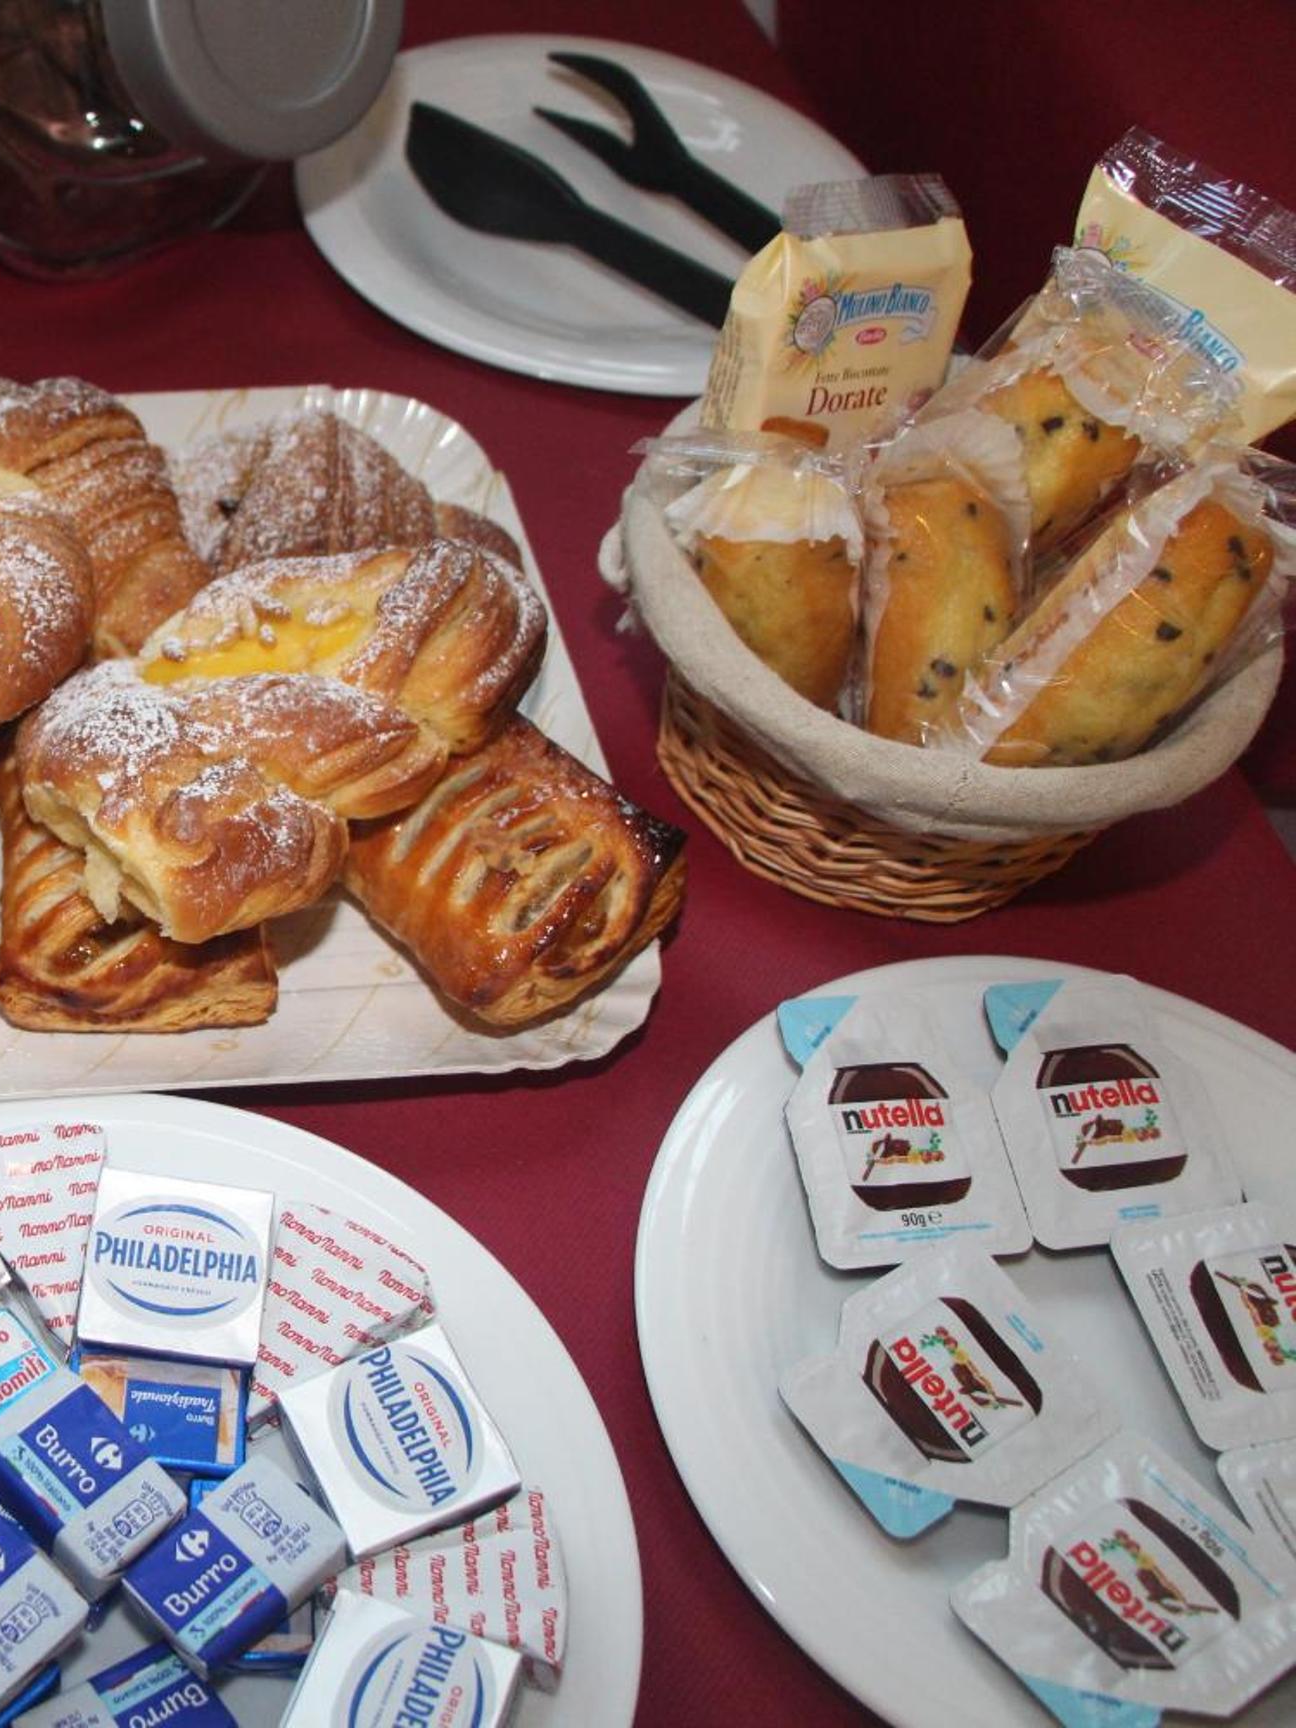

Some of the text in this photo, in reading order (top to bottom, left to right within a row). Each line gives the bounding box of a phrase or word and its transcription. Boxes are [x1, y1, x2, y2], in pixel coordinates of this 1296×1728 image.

[805, 385, 889, 417] Dorate
[841, 1096, 946, 1132] nutella
[1049, 1078, 1160, 1116] nutella
[93, 1230, 259, 1285] PHILADELPHIA
[142, 1223, 216, 1245] ORIGINAL
[413, 1380, 452, 1449] ORIGINAL
[892, 1335, 988, 1449] nutella
[35, 1423, 96, 1494] Burro
[357, 1345, 459, 1507] PHILADELPHIA
[162, 1552, 238, 1618] Burro
[1068, 1538, 1190, 1653] nutella
